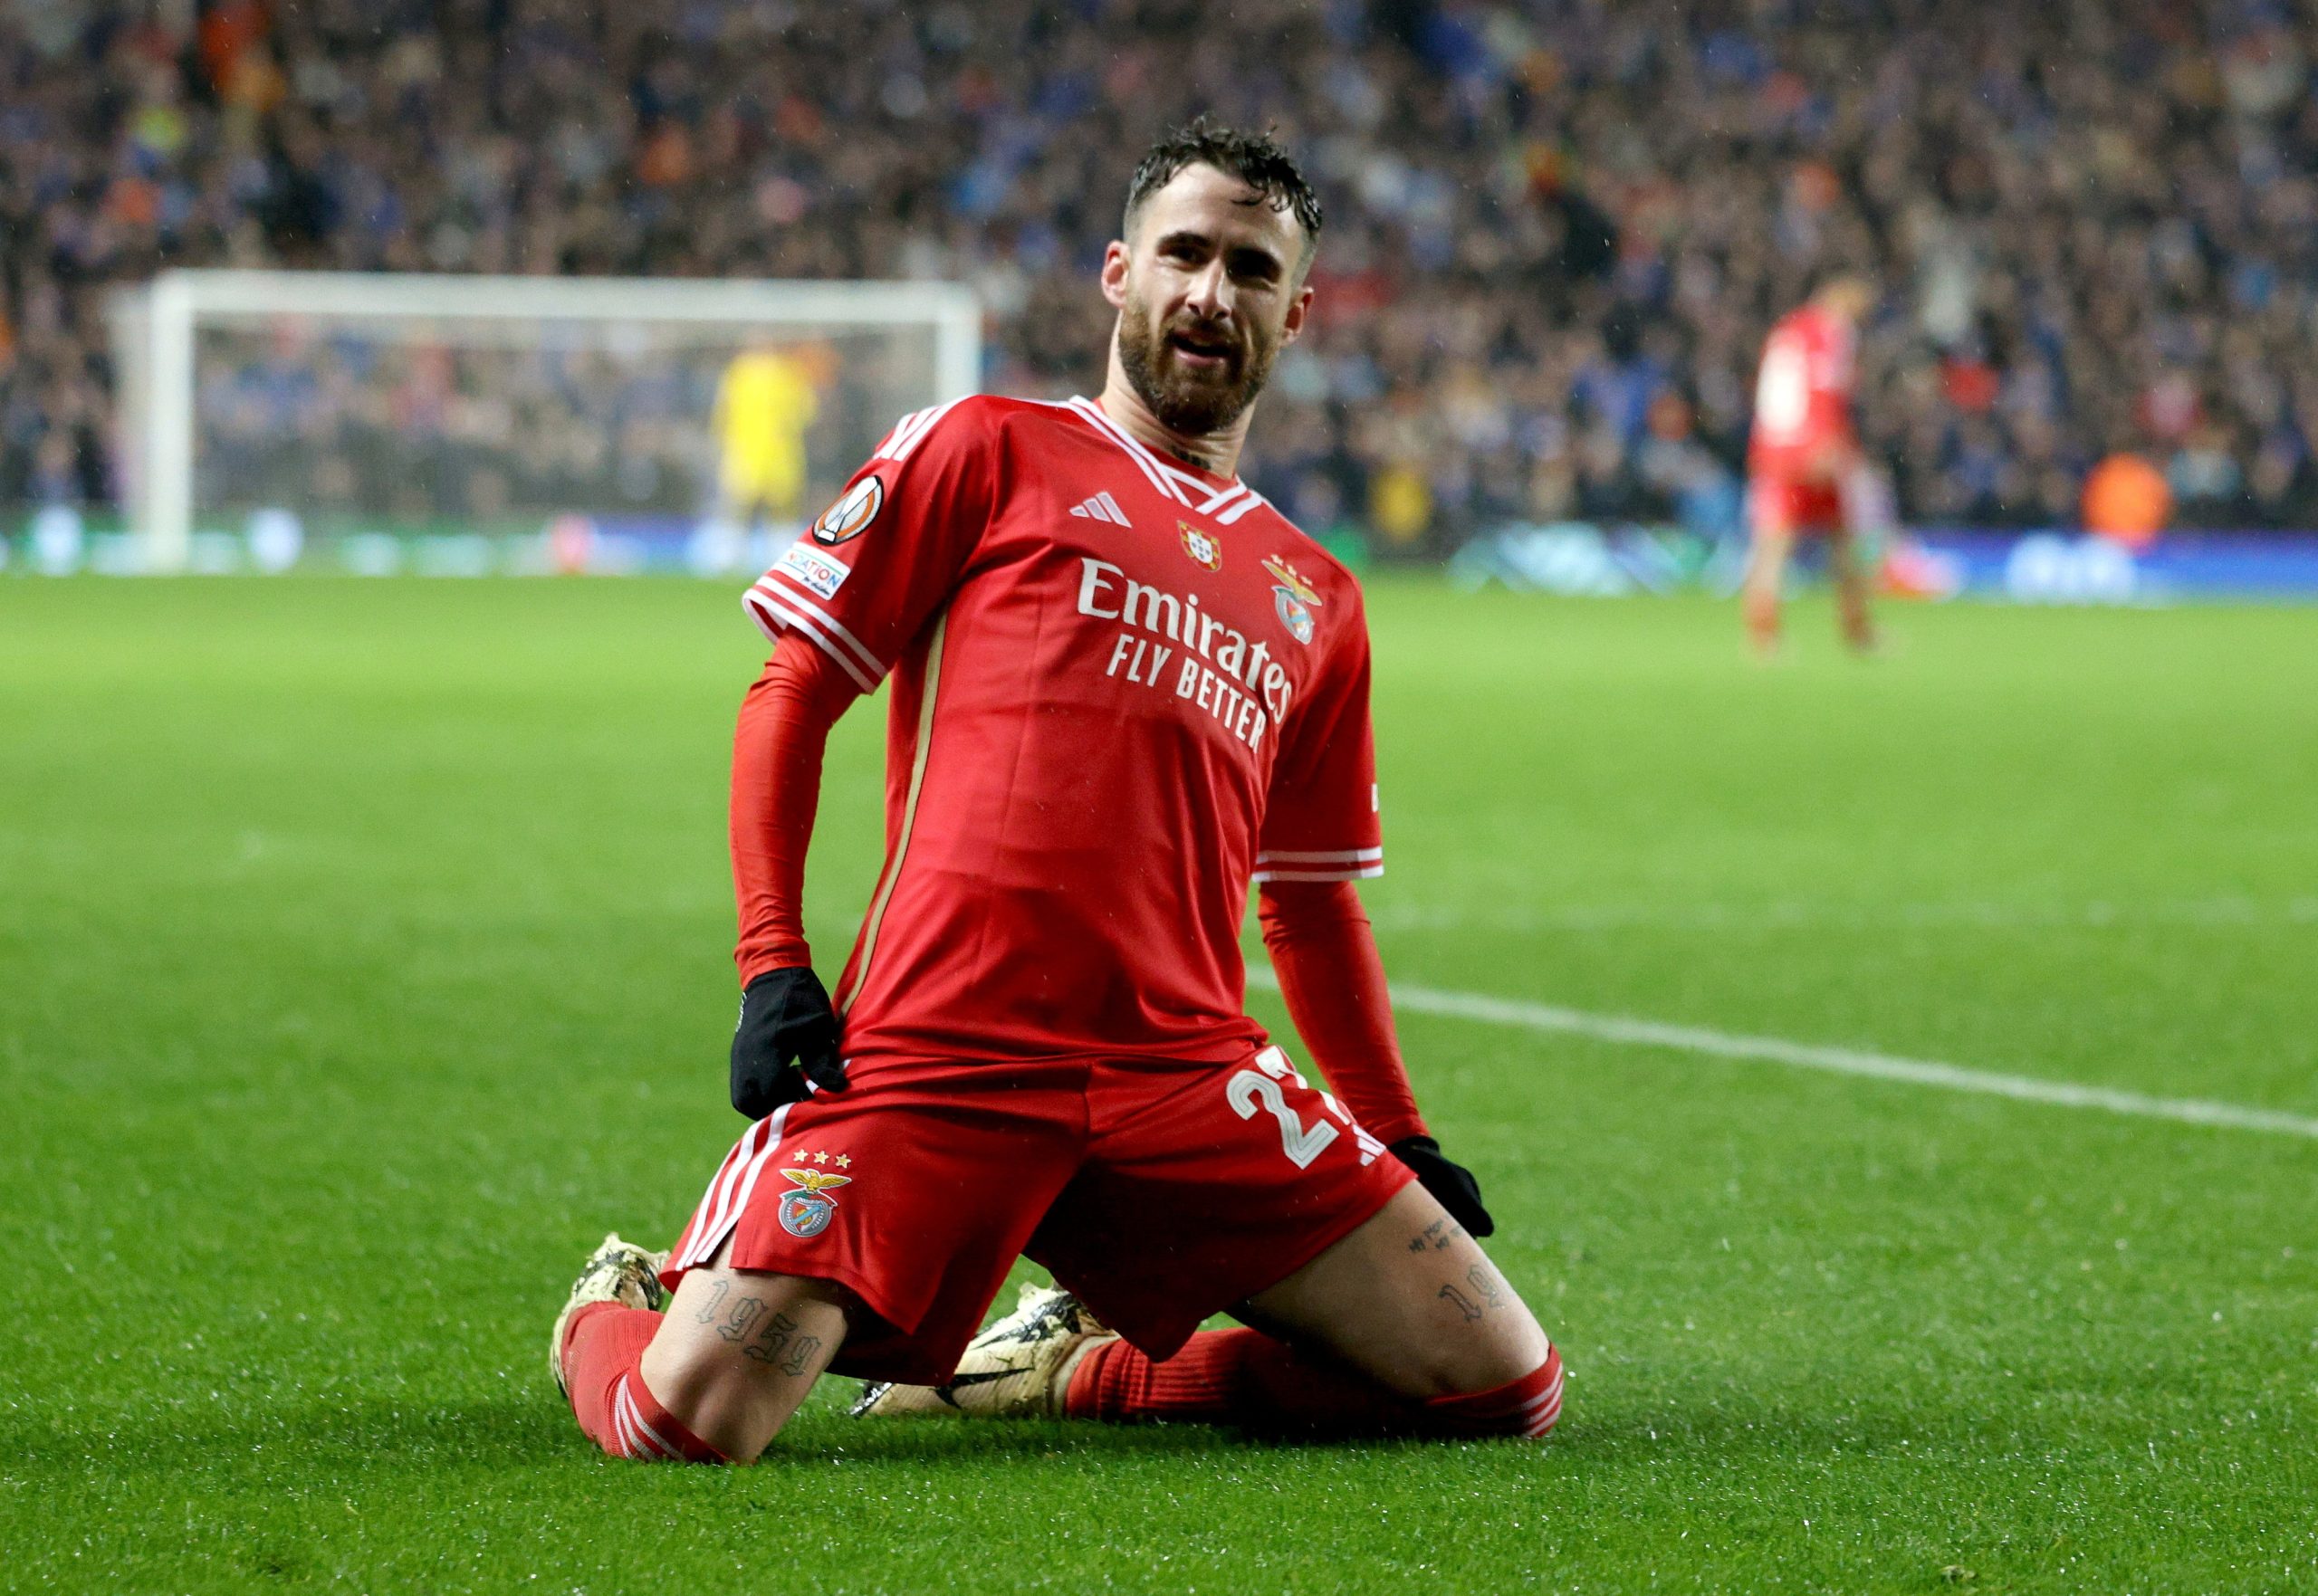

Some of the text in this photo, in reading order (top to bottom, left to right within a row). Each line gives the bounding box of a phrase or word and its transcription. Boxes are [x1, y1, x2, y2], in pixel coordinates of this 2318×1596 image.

[1078, 557, 1292, 724] Emirates
[1106, 633, 1267, 753] FLY BETTER
[695, 1279, 822, 1376] 1959
